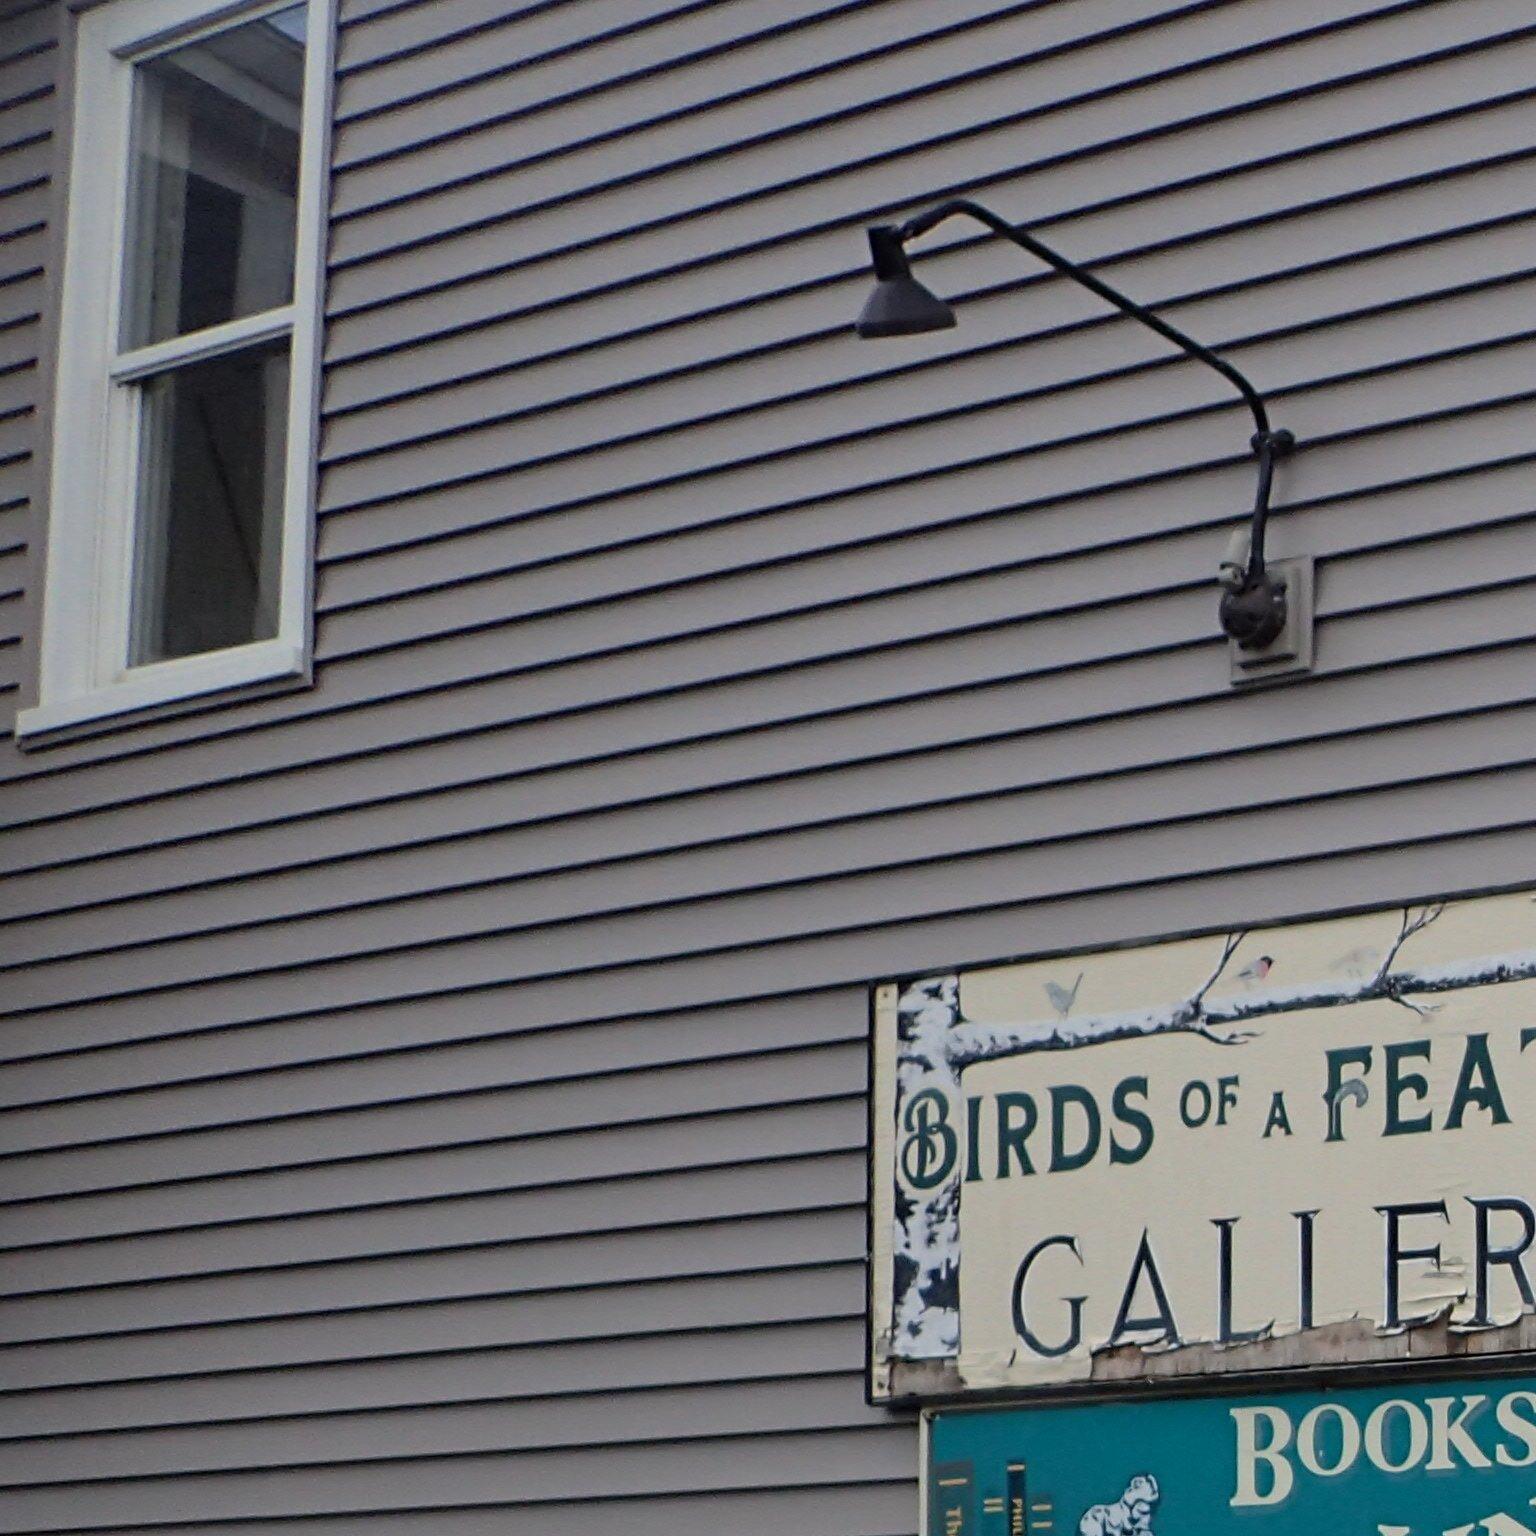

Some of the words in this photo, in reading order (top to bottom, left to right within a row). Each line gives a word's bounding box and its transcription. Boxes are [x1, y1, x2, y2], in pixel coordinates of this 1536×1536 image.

[899, 1075, 1156, 1191] BIRDS
[1179, 1075, 1240, 1129] OF
[1262, 1091, 1293, 1139] A
